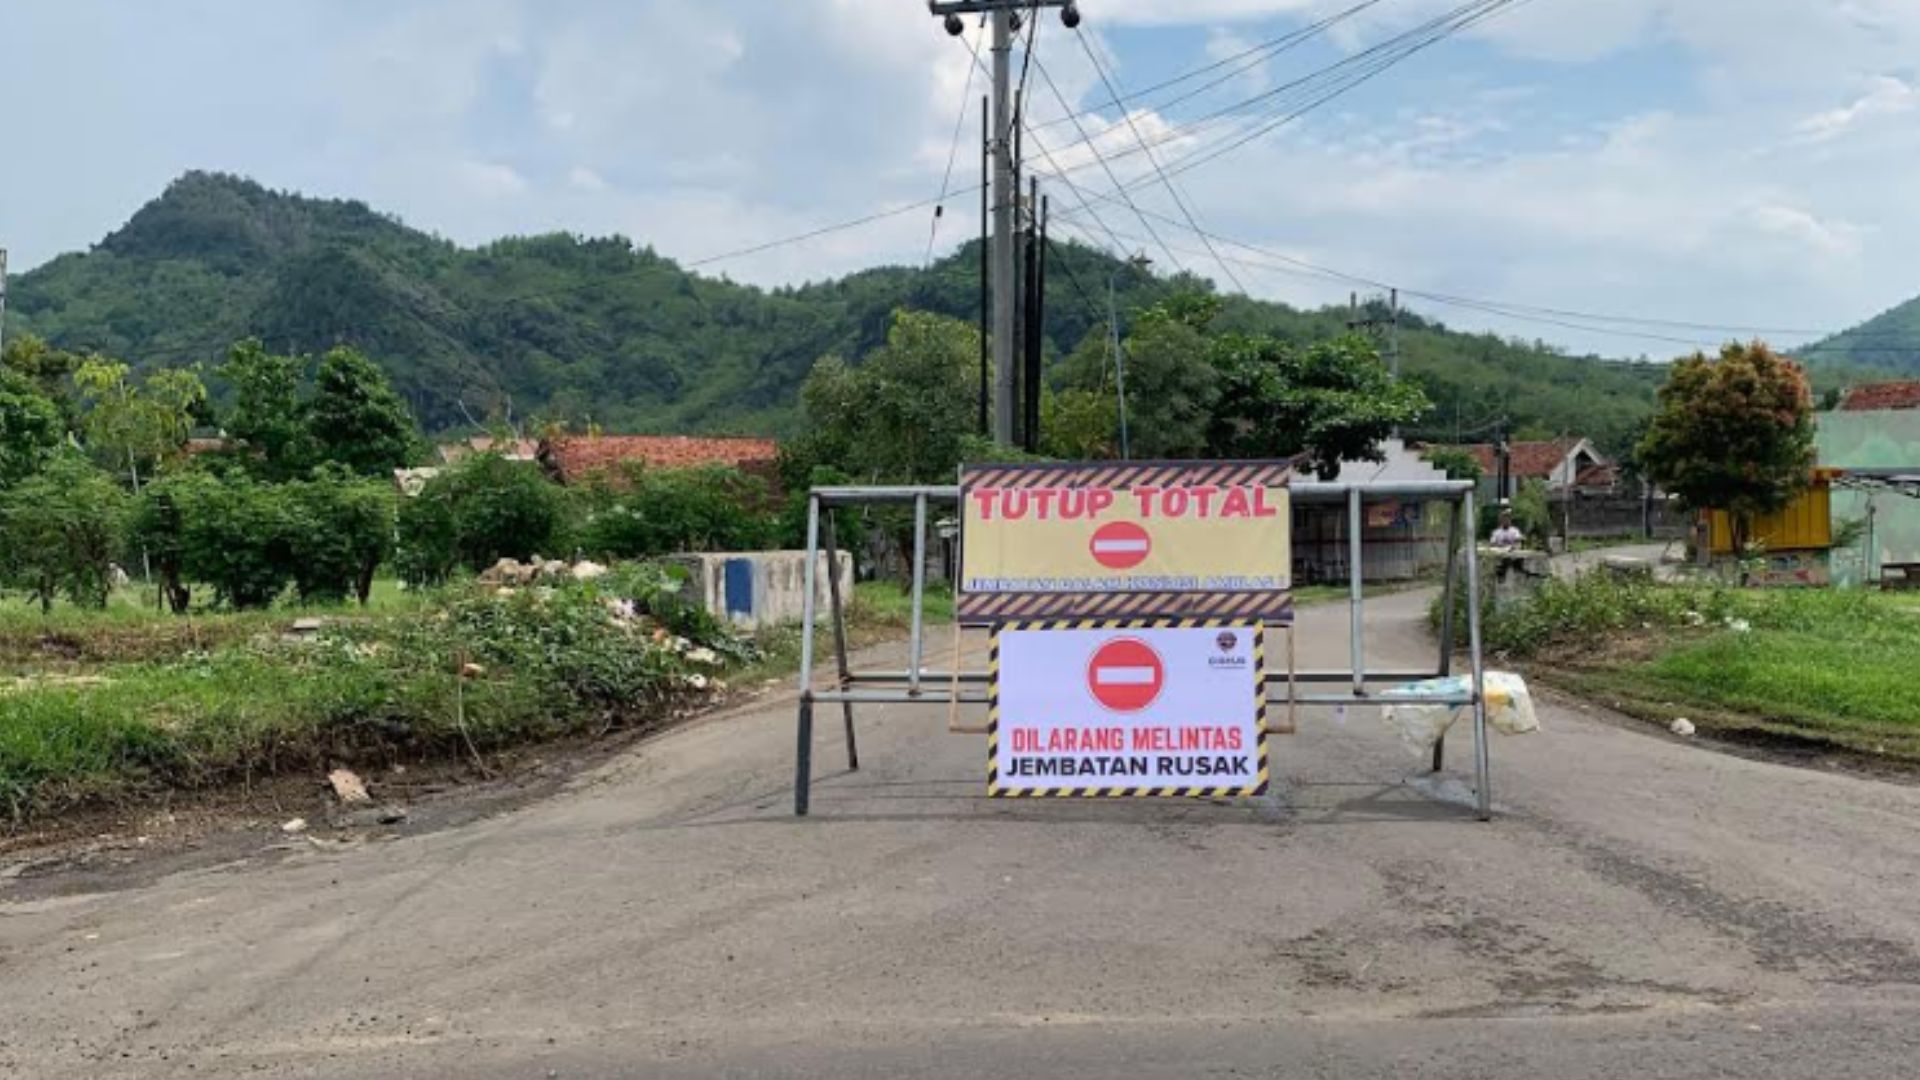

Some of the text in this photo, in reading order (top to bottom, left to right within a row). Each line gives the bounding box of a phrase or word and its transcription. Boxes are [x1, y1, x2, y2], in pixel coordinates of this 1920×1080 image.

[973, 484, 1277, 519] TUTUP TOTAL
[1012, 726, 1242, 751] DILARANG MELINTAS
[1006, 756, 1249, 776] JEMBATAN RUSAK
